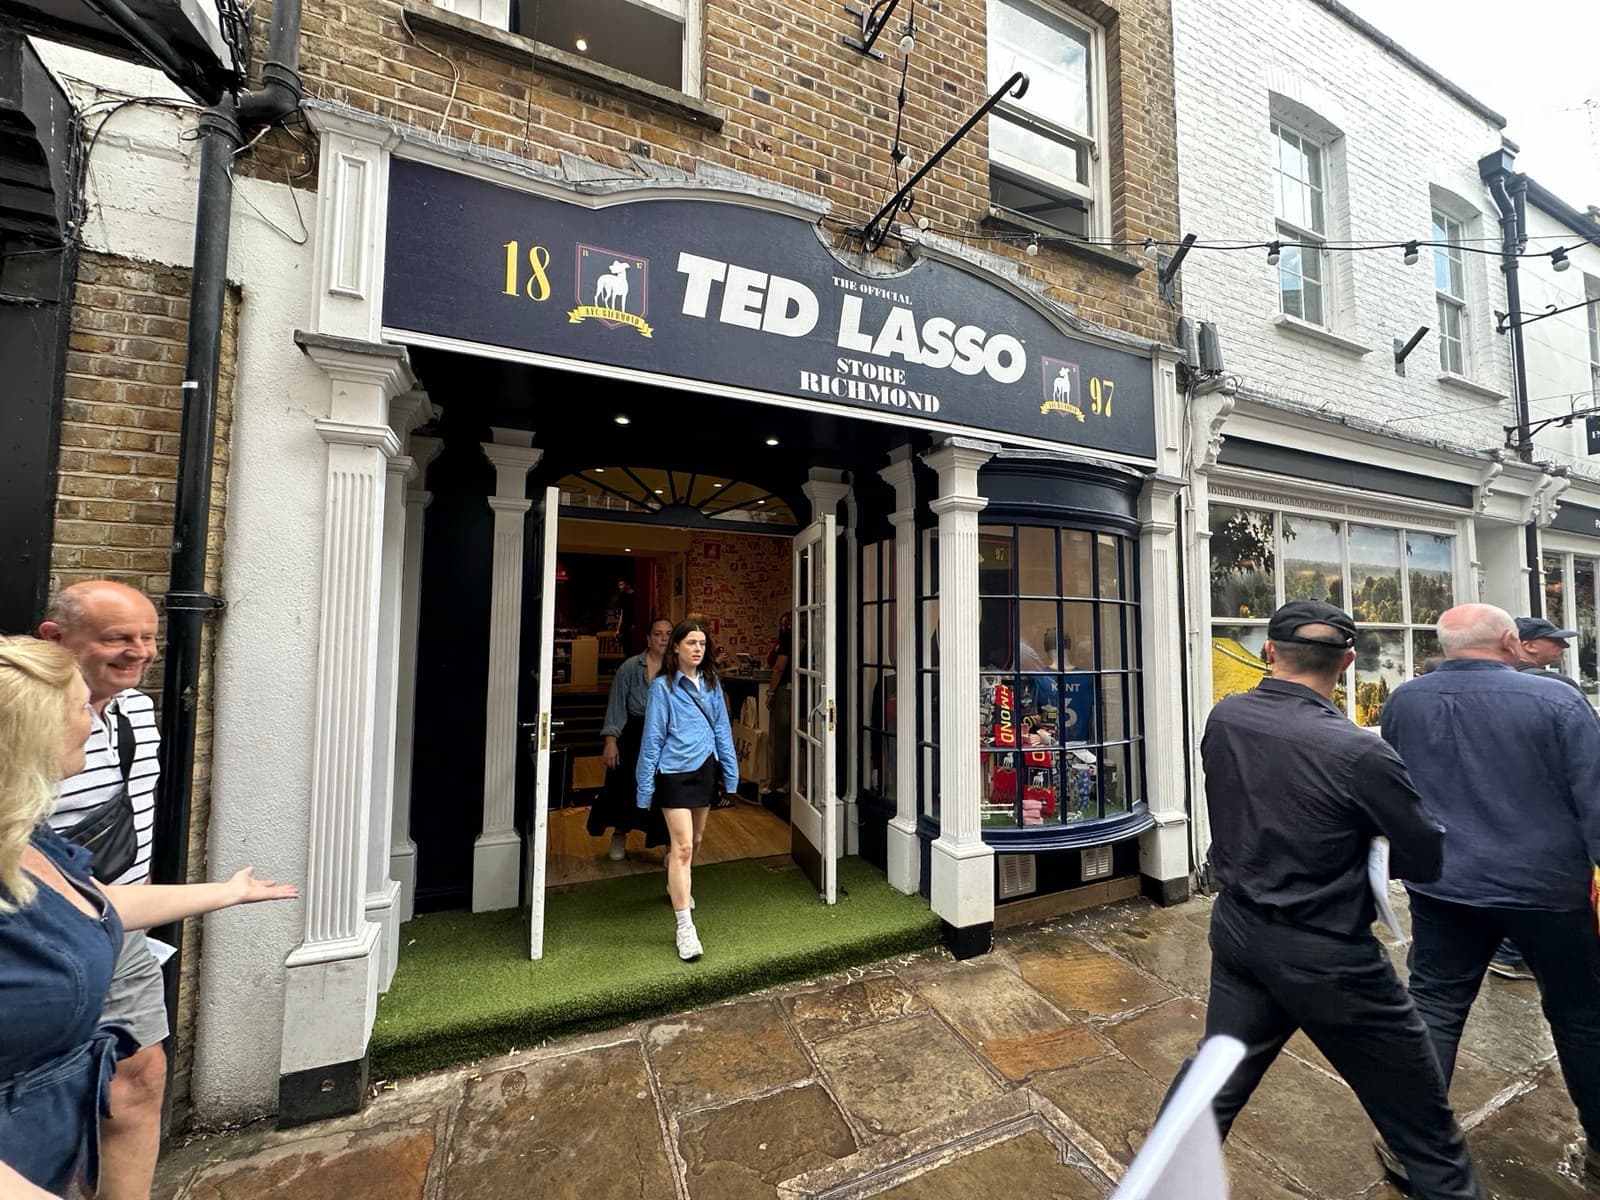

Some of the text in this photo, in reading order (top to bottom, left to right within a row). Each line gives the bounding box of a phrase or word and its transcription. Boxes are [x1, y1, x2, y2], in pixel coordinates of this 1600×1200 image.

[502, 240, 552, 302] 18
[832, 275, 913, 306] THE OFFICIAL
[676, 251, 820, 338] TED
[836, 294, 1027, 384] LASSO
[799, 369, 941, 414] RICHMOND
[836, 356, 906, 386] STORE
[1089, 376, 1115, 418] 97
[1050, 683, 1081, 692] KNT
